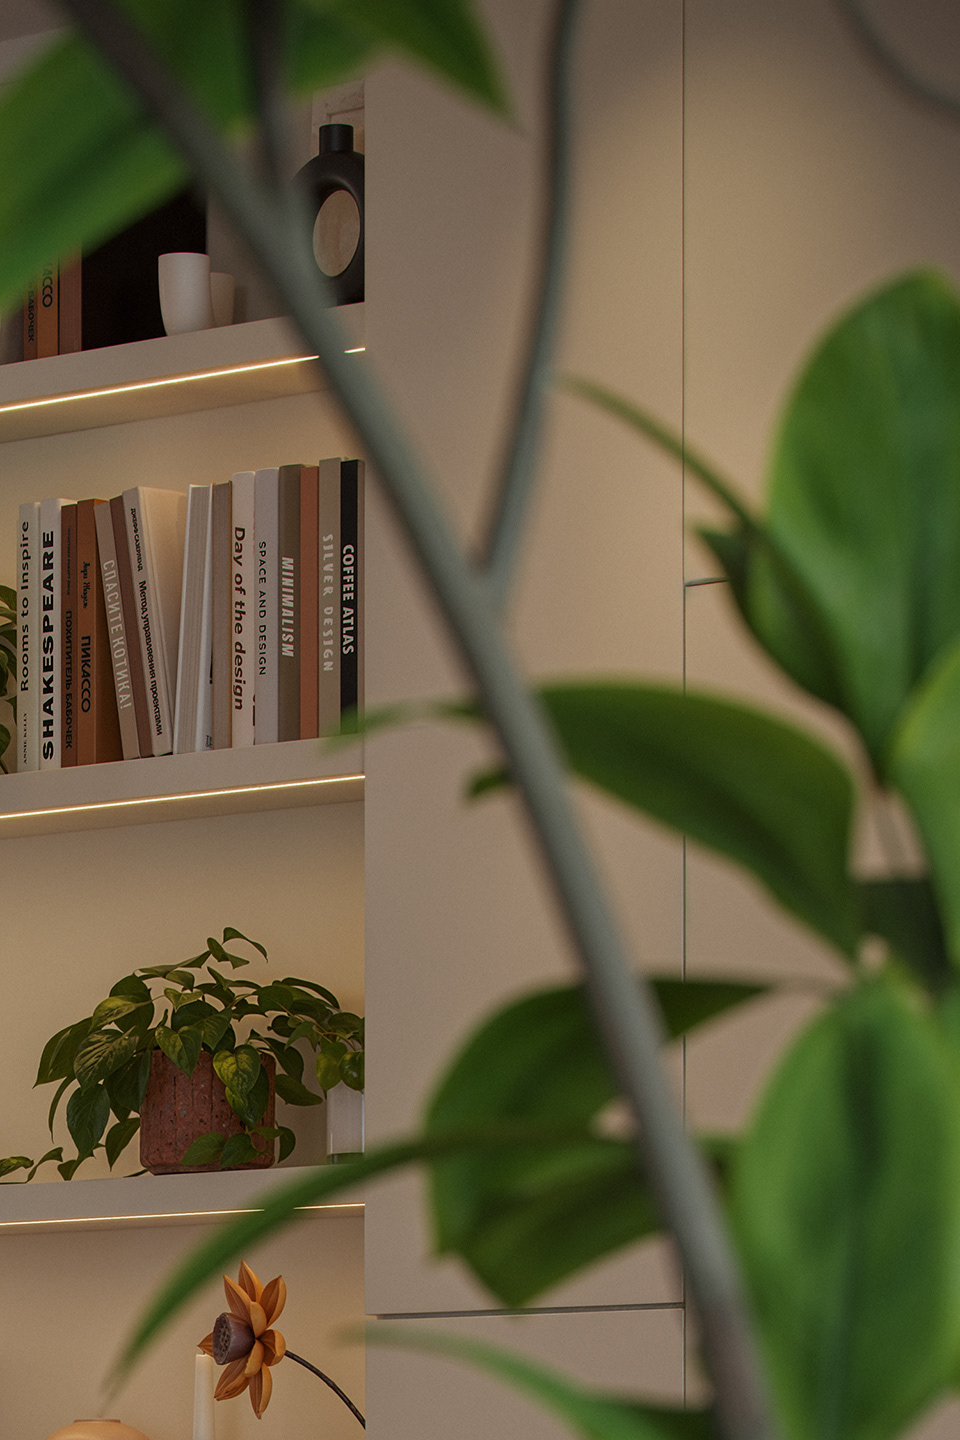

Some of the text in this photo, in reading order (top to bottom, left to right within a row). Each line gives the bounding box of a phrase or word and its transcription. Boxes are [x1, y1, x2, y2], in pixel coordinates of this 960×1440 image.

[130, 508, 139, 533] ДЖЕФФ
[20, 521, 31, 692] Rooms to Inspire
[42, 530, 54, 760] SHAKESPEARE
[103, 559, 132, 710] СПАСИТЕ КОТИКА!
[138, 580, 164, 736] Метод управления проектами
[233, 526, 246, 711] Day of the design
[259, 541, 267, 676] SPACE AND DESIGN
[281, 556, 294, 657] MINIMALISM
[322, 533, 334, 672] SILVER DESIGN
[342, 543, 354, 655] COFFEE ATLAS
[65, 610, 73, 749] ПОХИТИТЕЛЬ БАБОЧЕК
[81, 635, 91, 713] ПИКАССО
